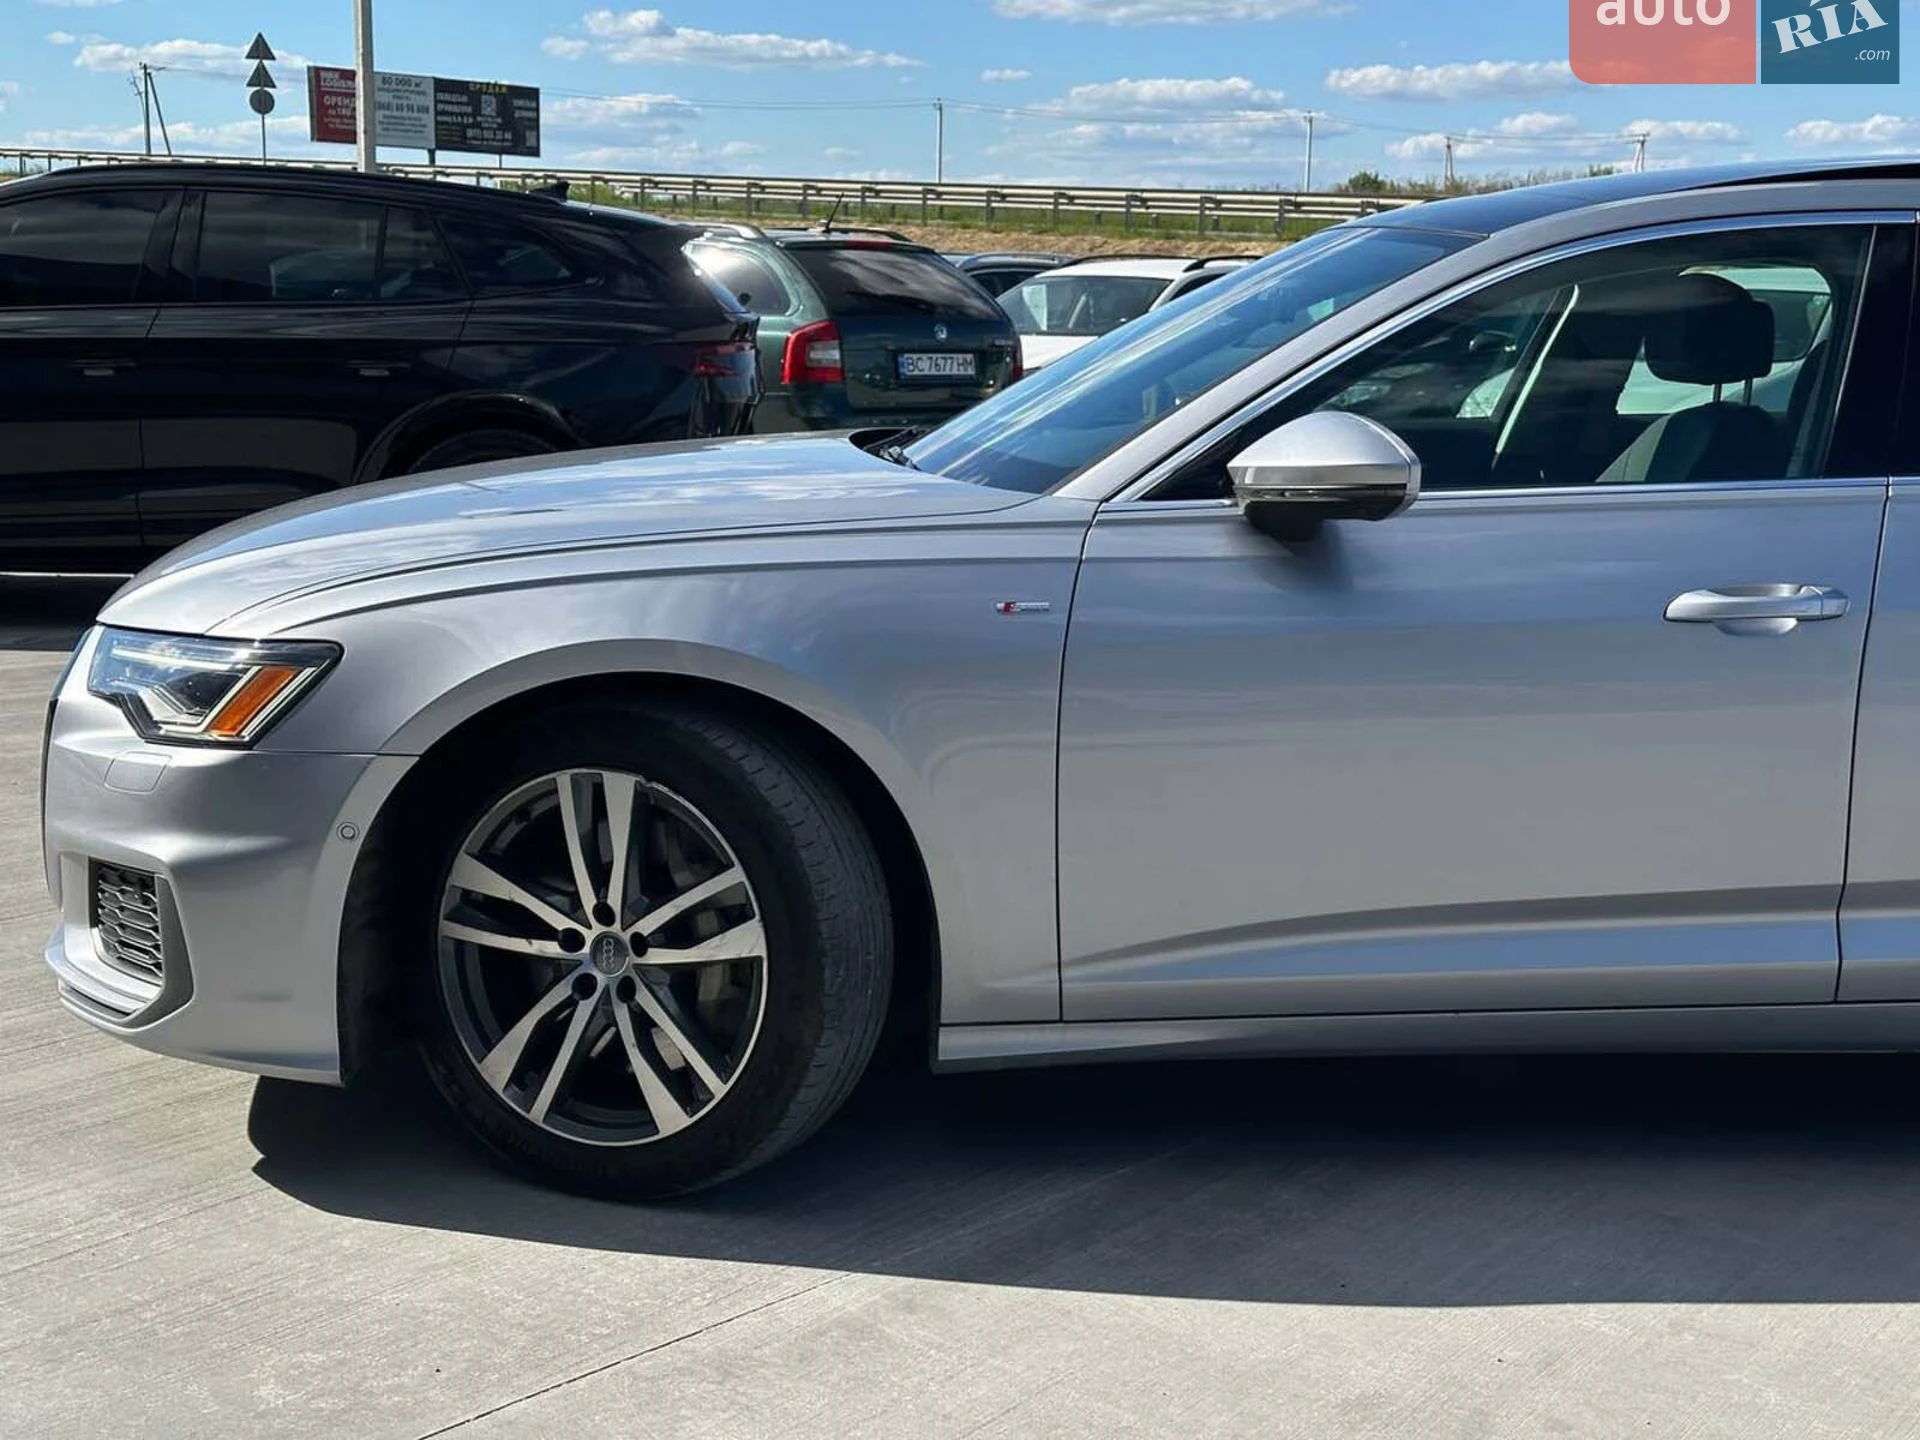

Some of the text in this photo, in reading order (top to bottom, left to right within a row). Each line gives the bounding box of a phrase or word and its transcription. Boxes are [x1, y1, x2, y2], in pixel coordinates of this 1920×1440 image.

[906, 356, 925, 373] BC
[926, 356, 955, 373] 7677
[956, 356, 974, 373] HM
